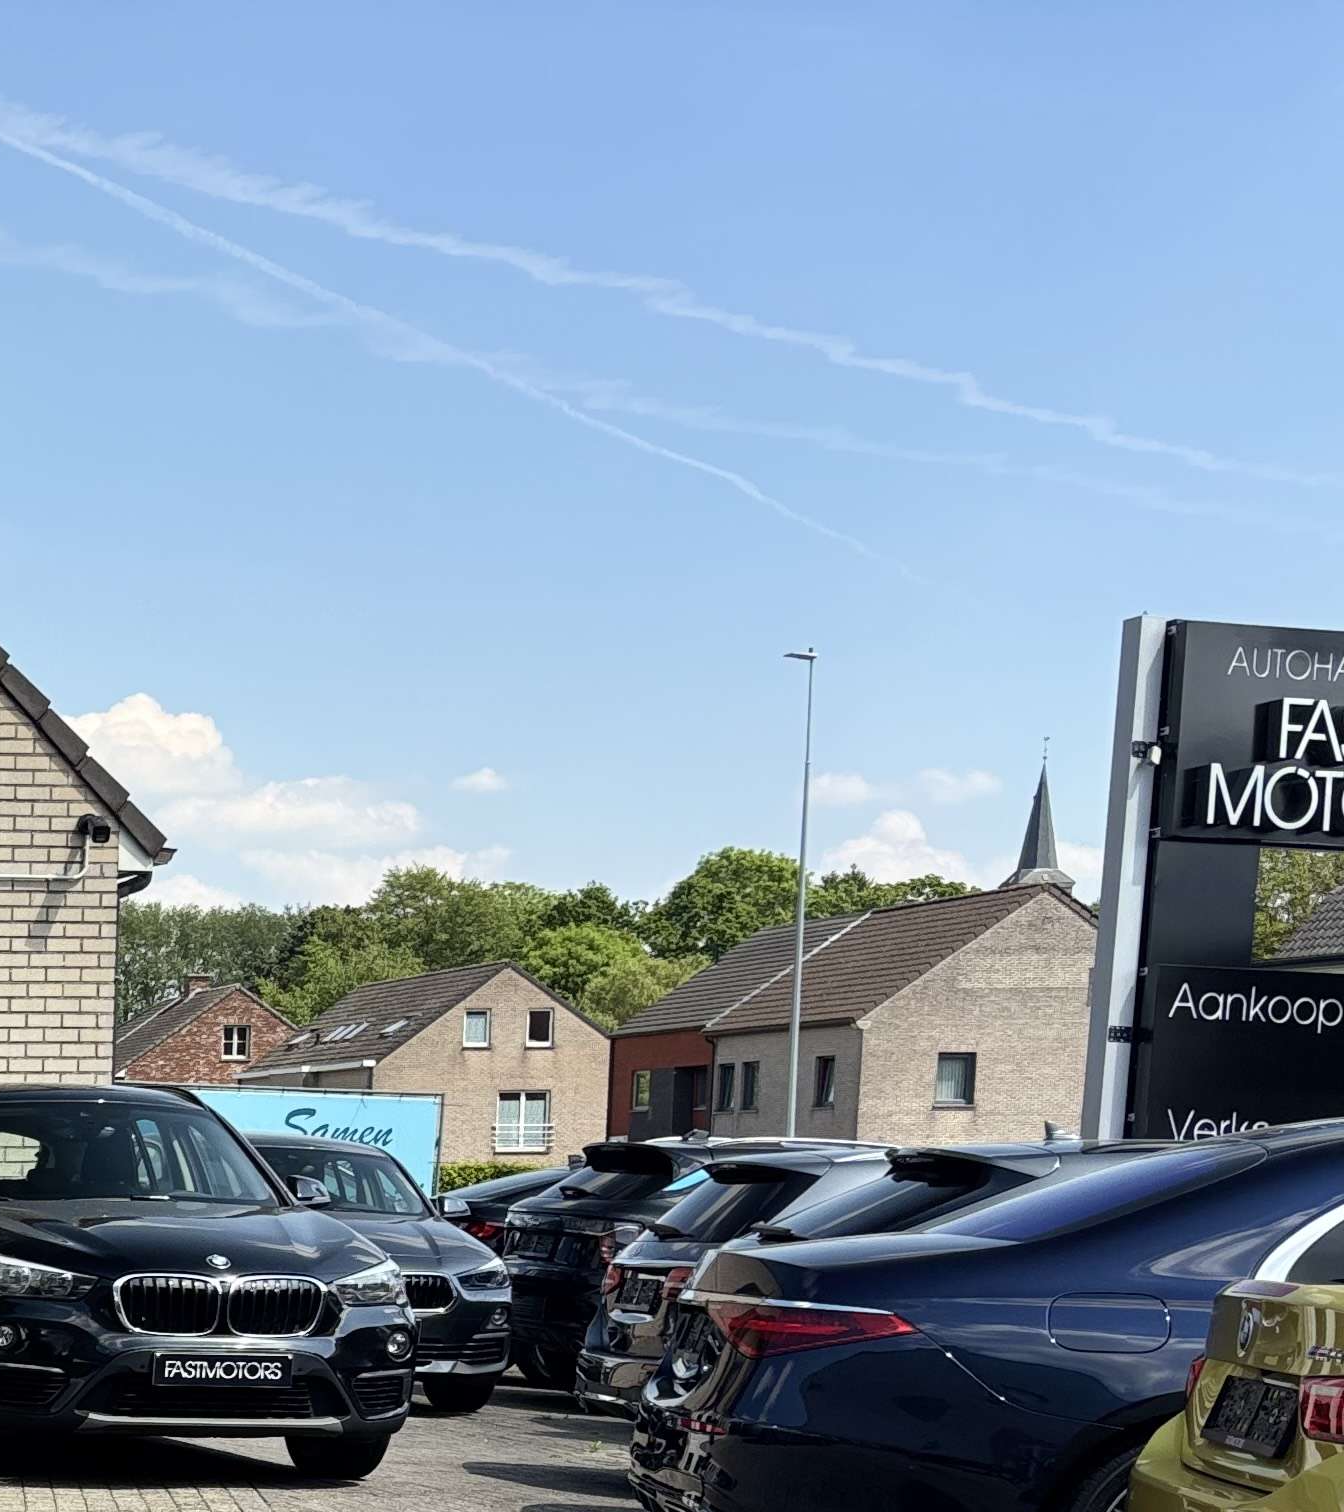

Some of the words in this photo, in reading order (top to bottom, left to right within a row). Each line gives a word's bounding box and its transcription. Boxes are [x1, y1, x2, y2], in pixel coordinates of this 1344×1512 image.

[1278, 696, 1344, 763] FA
[1206, 761, 1344, 832] MOT
[1168, 981, 1344, 1034] Aankoop
[285, 1107, 394, 1147] Samen
[164, 1360, 282, 1380] FASTMOTORS
